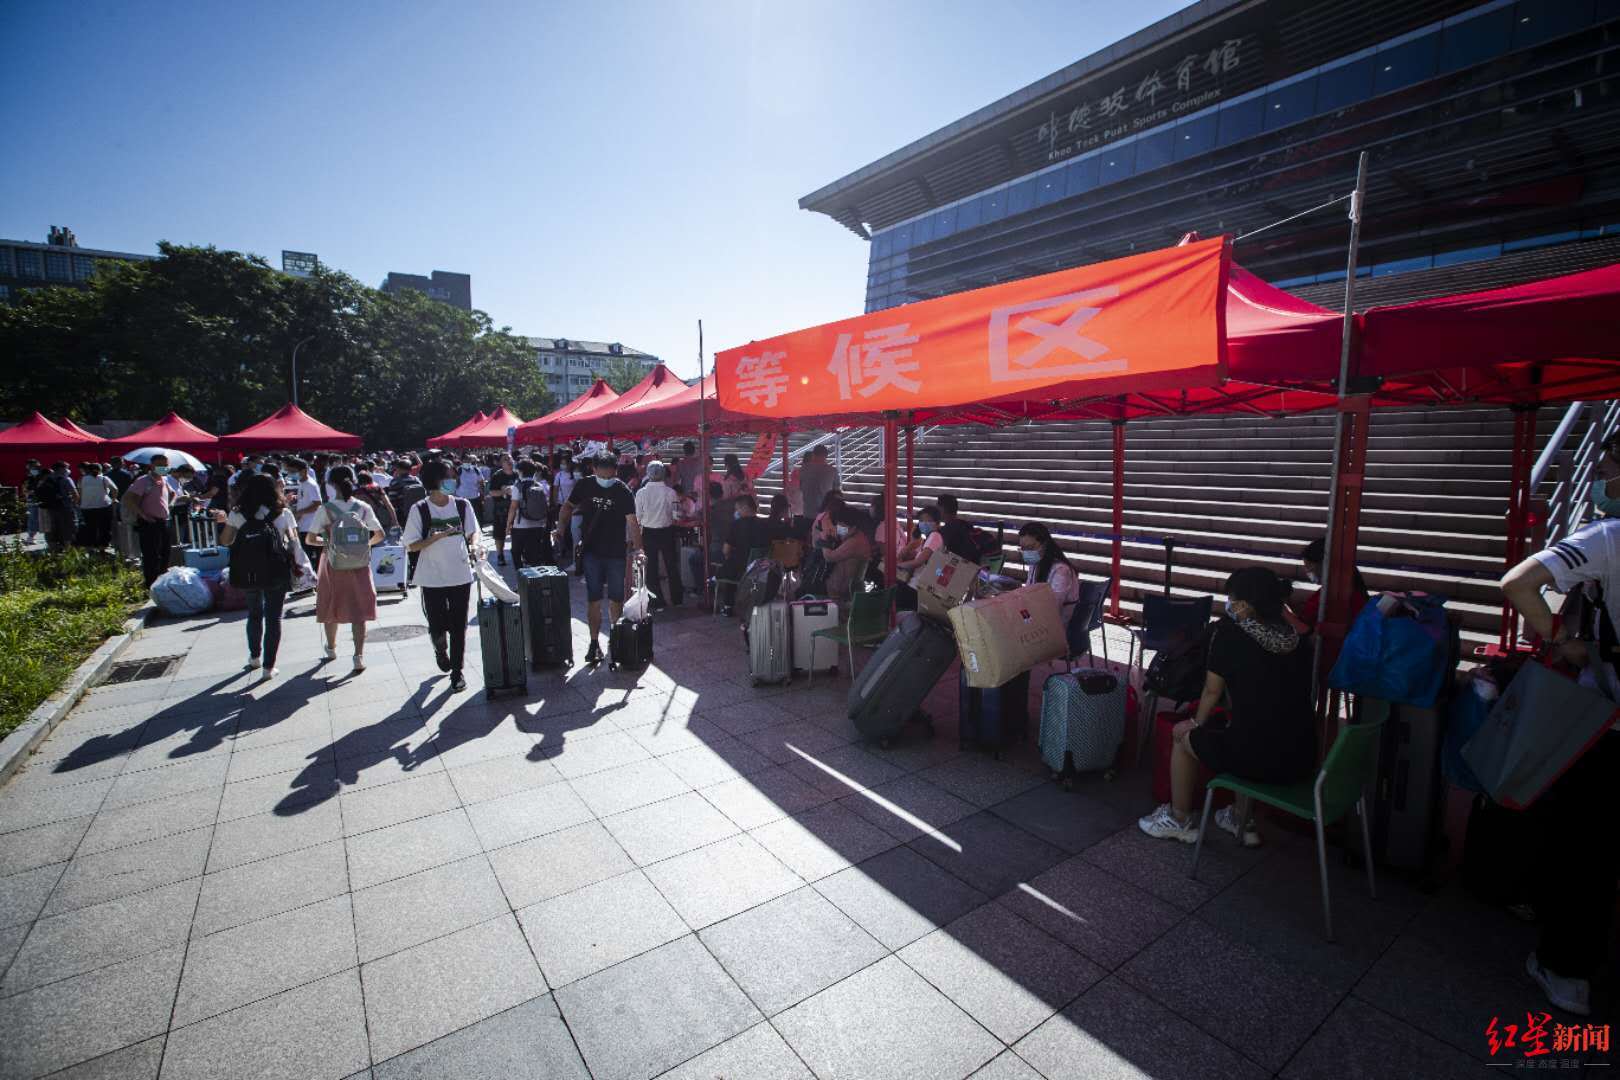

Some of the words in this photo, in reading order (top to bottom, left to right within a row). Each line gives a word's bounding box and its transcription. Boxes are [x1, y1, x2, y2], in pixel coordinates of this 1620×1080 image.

[1048, 145, 1072, 161] Khoo
[1076, 134, 1099, 148] Teck
[1104, 124, 1128, 140] Puat
[1133, 109, 1167, 130] Sports
[1172, 88, 1221, 114] Complex
[735, 284, 1128, 408] 等候区
